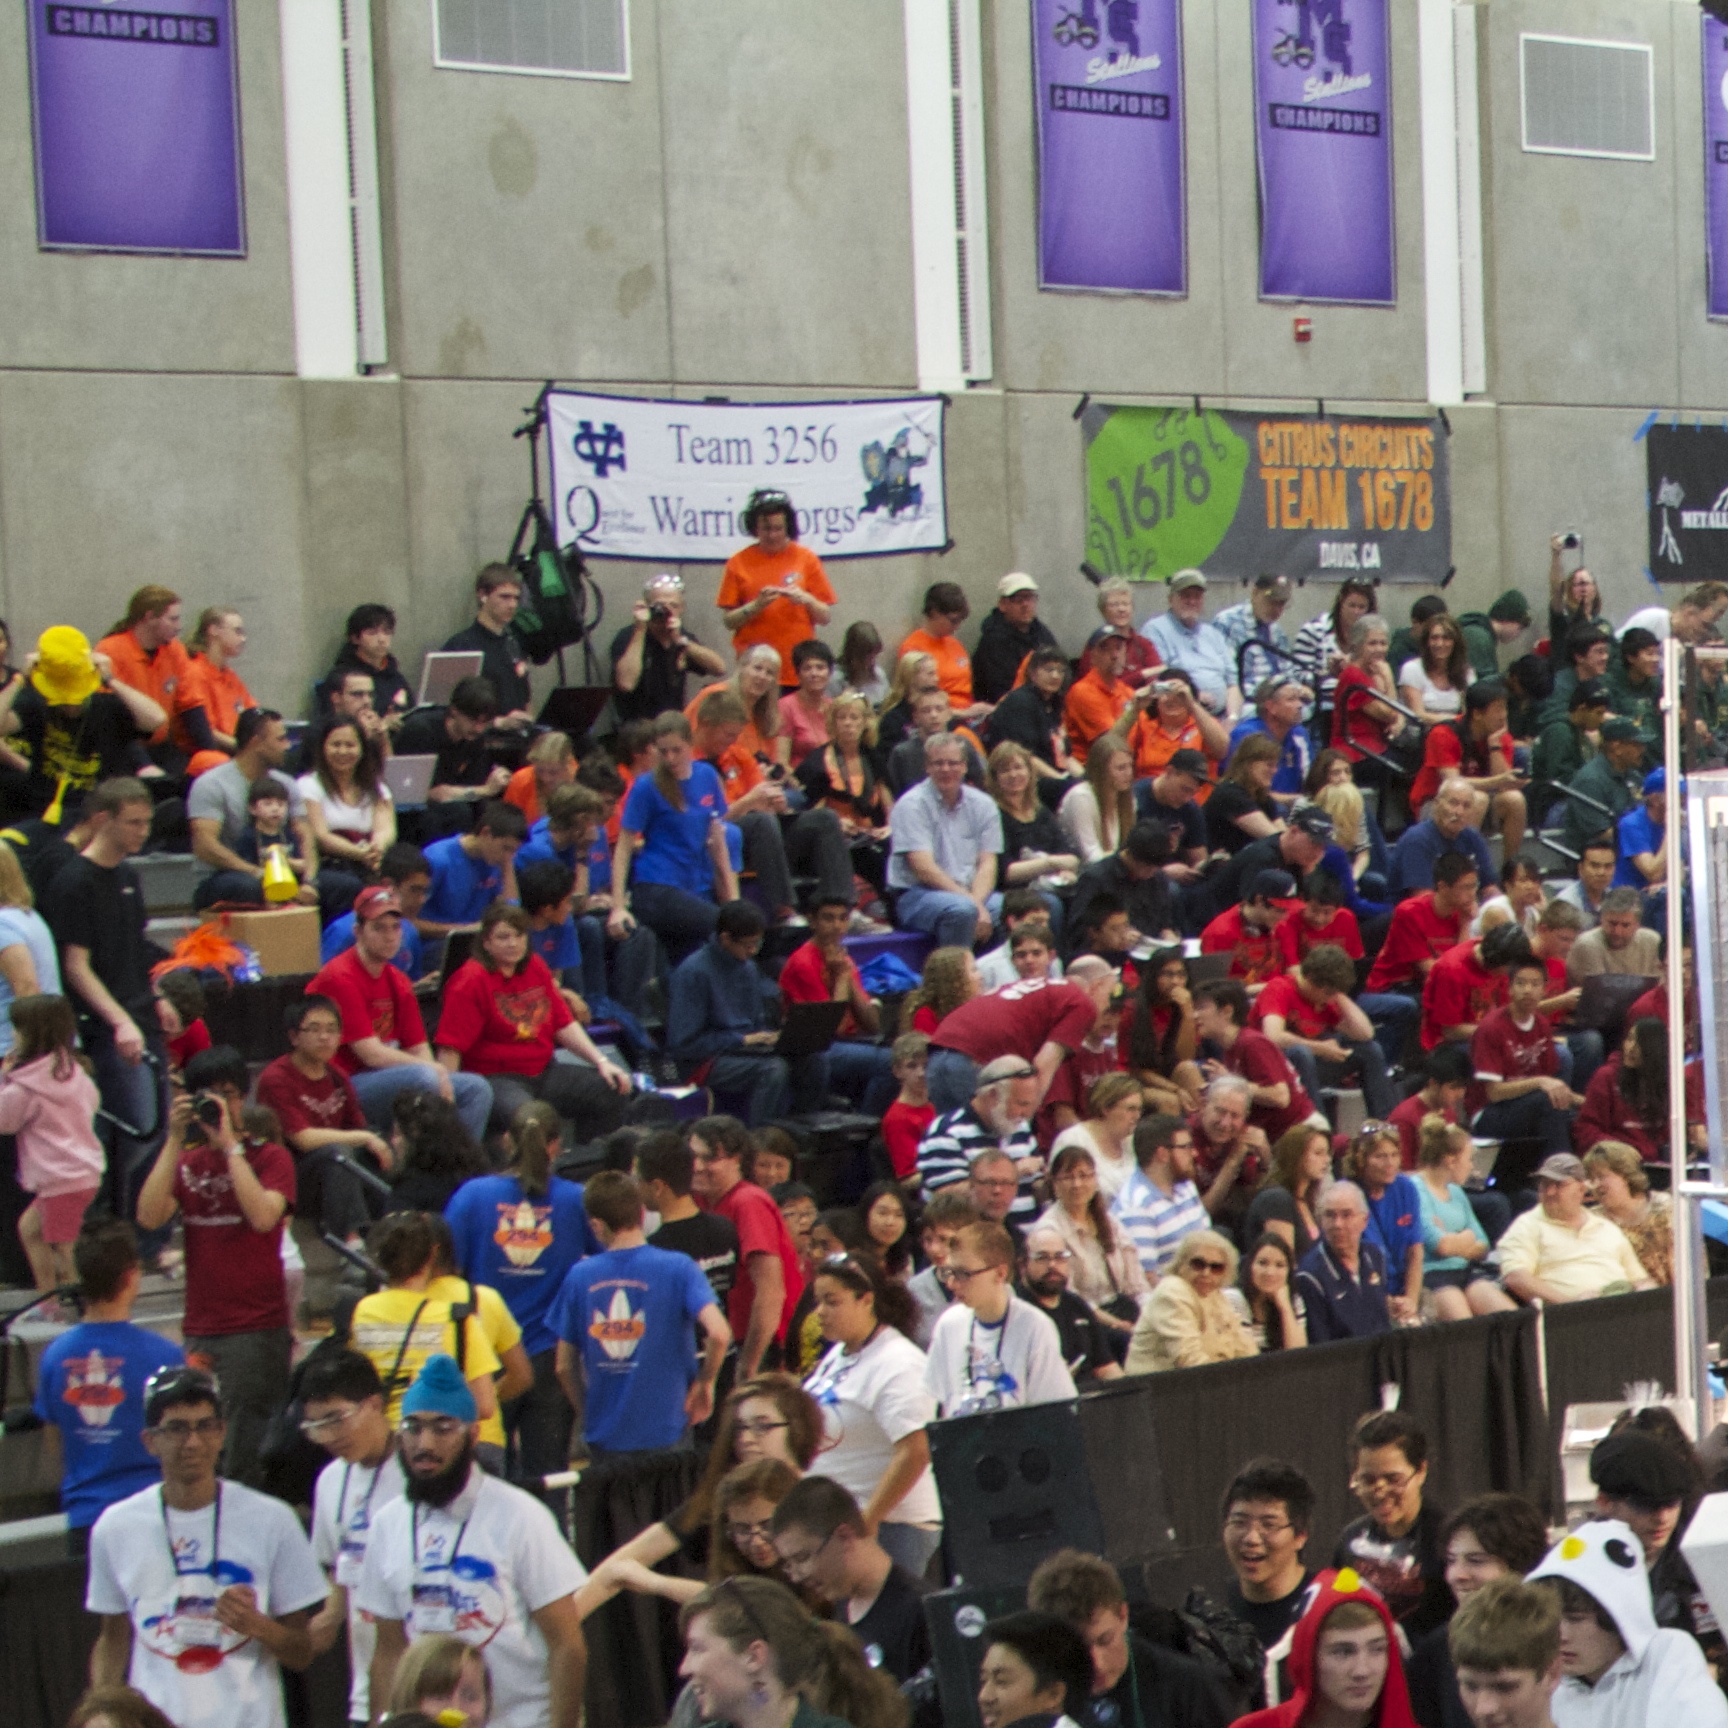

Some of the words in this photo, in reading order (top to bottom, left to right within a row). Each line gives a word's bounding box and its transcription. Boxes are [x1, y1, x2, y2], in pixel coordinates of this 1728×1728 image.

[54, 9, 213, 43] CHAMPIONS
[1054, 87, 1168, 117] CHAMPIONS
[1274, 107, 1377, 134] CHAMPIONS
[668, 424, 754, 466] Team
[764, 422, 839, 466] 3256
[1258, 421, 1336, 467] CITRUS
[1339, 424, 1435, 470] CIRCUITS
[1107, 440, 1212, 539] 1678
[1260, 467, 1350, 530] TEAM
[1357, 470, 1435, 531] 1678
[1319, 542, 1361, 570] DAVIS,
[1361, 543, 1382, 568] CA
